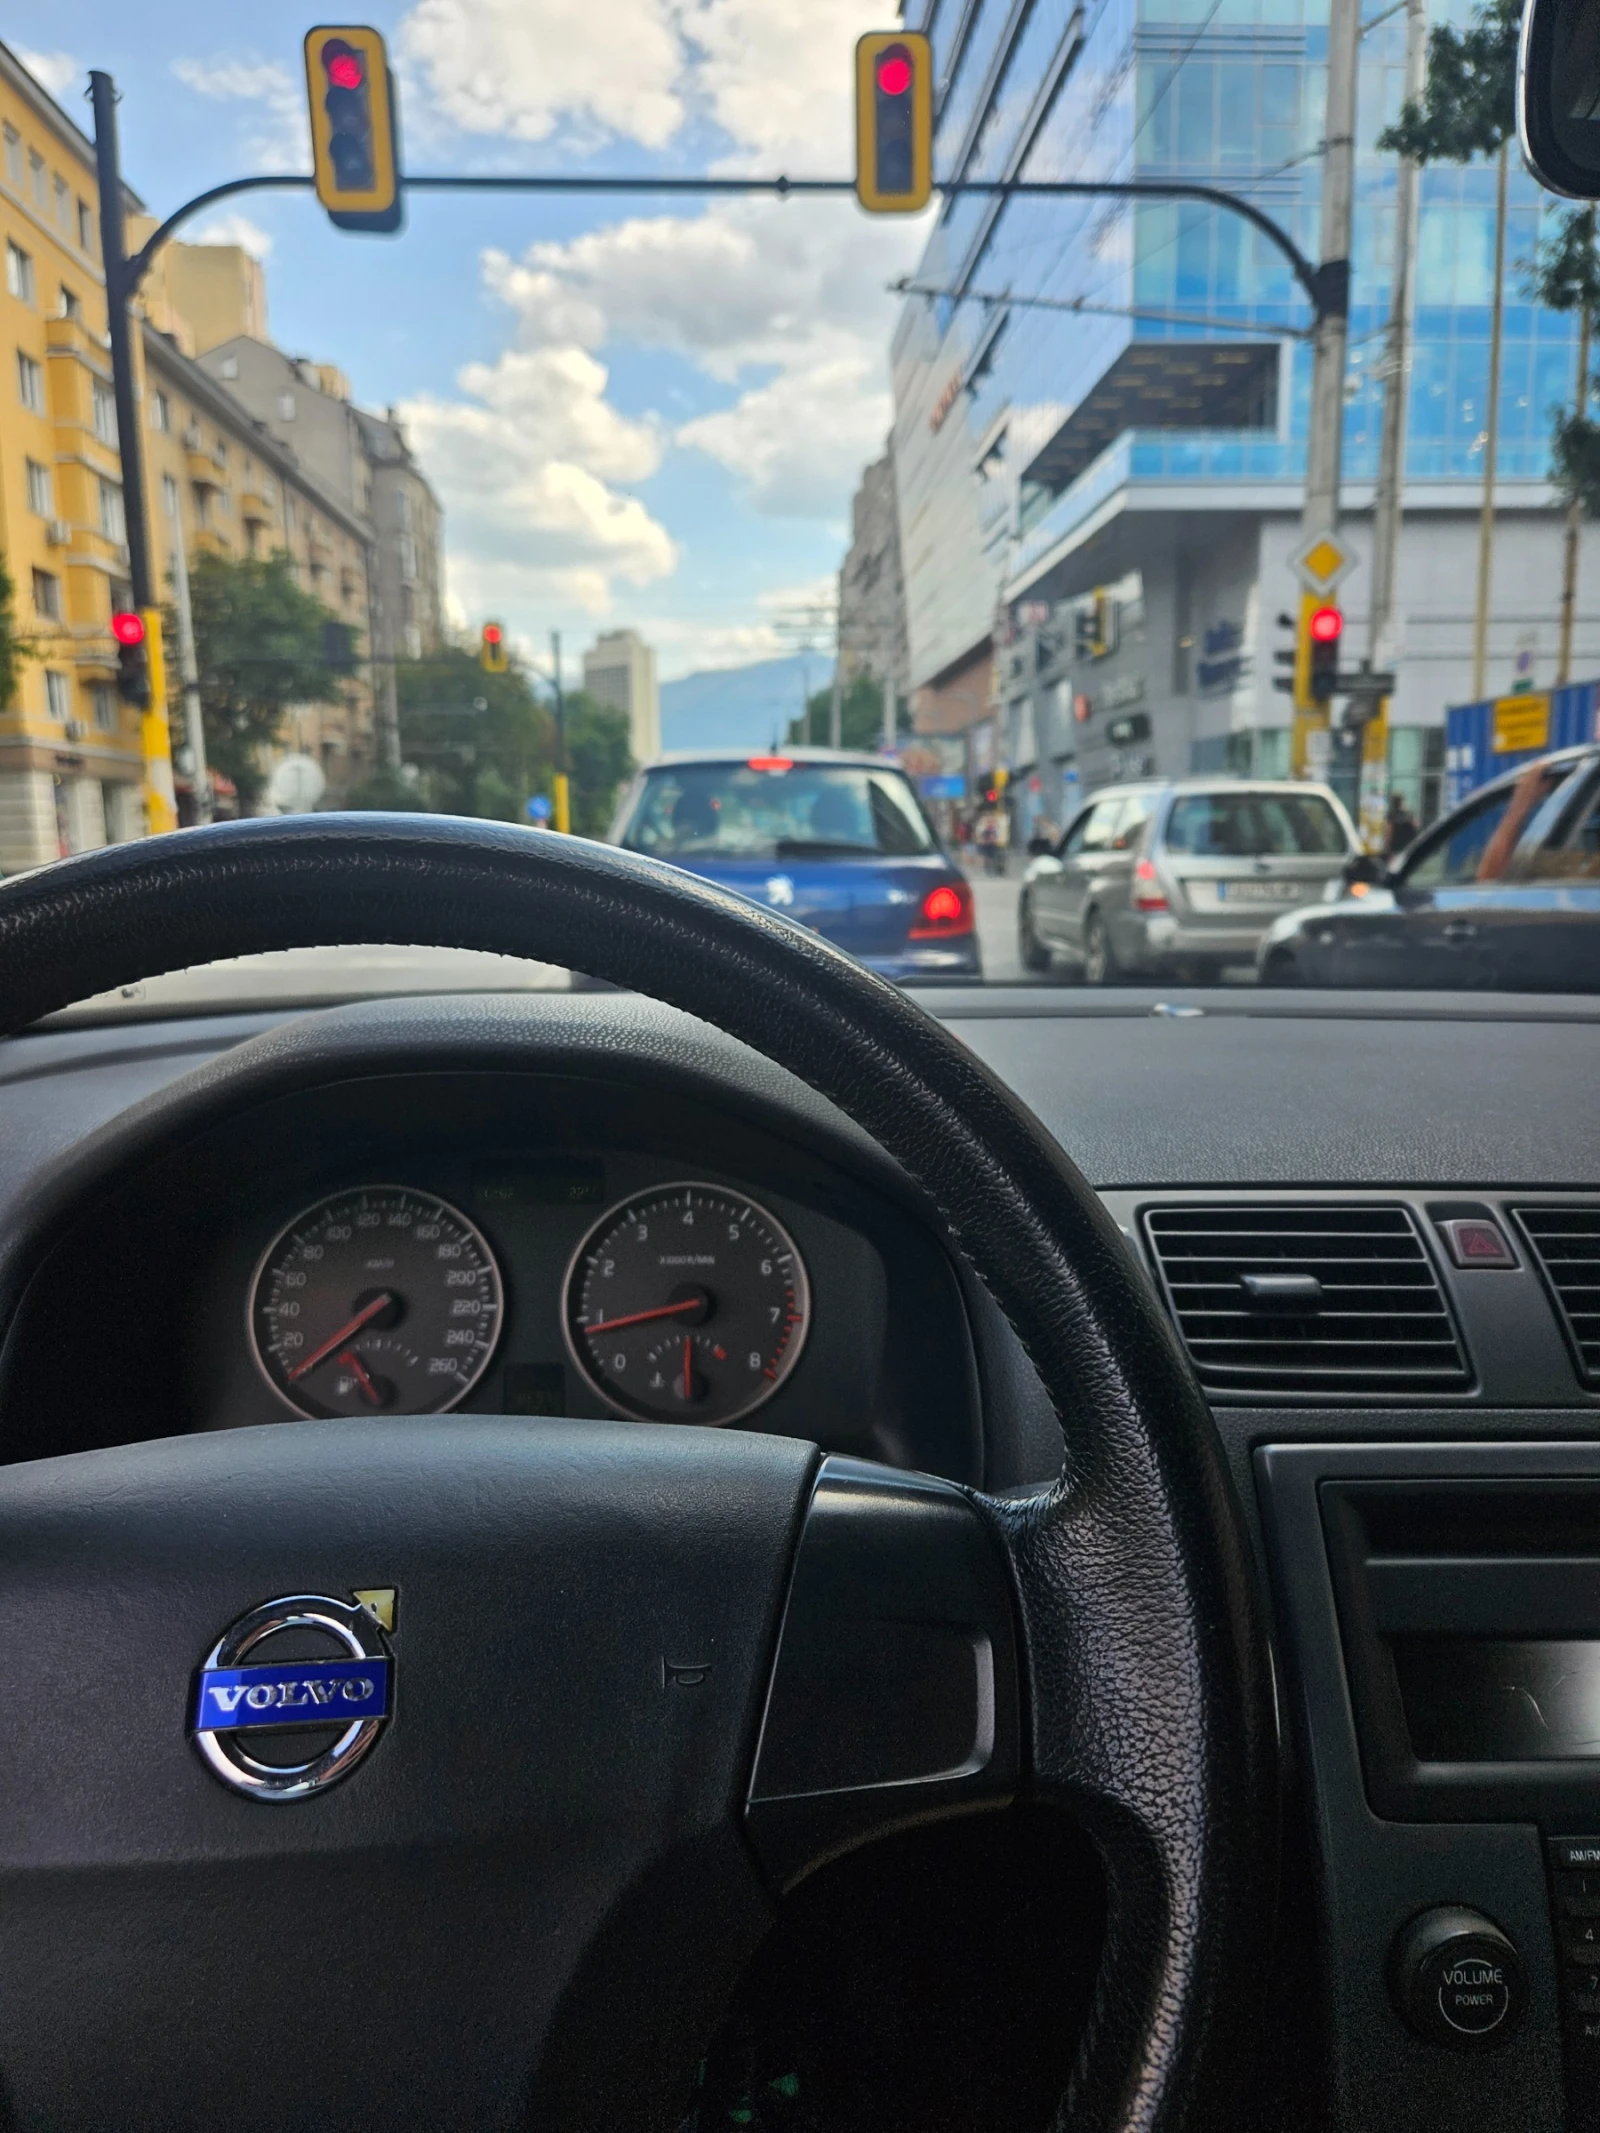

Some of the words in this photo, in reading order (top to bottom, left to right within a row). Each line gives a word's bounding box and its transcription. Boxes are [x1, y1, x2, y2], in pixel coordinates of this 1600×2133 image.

[357, 1212, 380, 1226] 120
[387, 1212, 411, 1226] 140
[682, 1210, 694, 1225] 4
[327, 1225, 352, 1239] 100
[416, 1224, 440, 1239] 160
[637, 1225, 648, 1240] 3
[728, 1225, 740, 1240] 5
[304, 1245, 324, 1260] 80
[438, 1244, 461, 1258] 180
[603, 1260, 615, 1277] 2
[760, 1260, 772, 1275] 6
[286, 1272, 306, 1286] 60
[447, 1270, 476, 1284] 200
[279, 1302, 300, 1316] 40
[453, 1300, 481, 1314] 220
[769, 1307, 780, 1323] 7
[283, 1333, 303, 1346] 20
[447, 1330, 474, 1344] 240
[429, 1358, 457, 1372] 260
[614, 1354, 626, 1369] 0
[750, 1353, 761, 1367] 8
[209, 1677, 374, 1711] VOLVO
[1585, 1929, 1594, 1941] 4
[1443, 1969, 1503, 1986] VOLUME
[1590, 1976, 1598, 1990] 7
[1455, 1994, 1493, 2006] POWER
